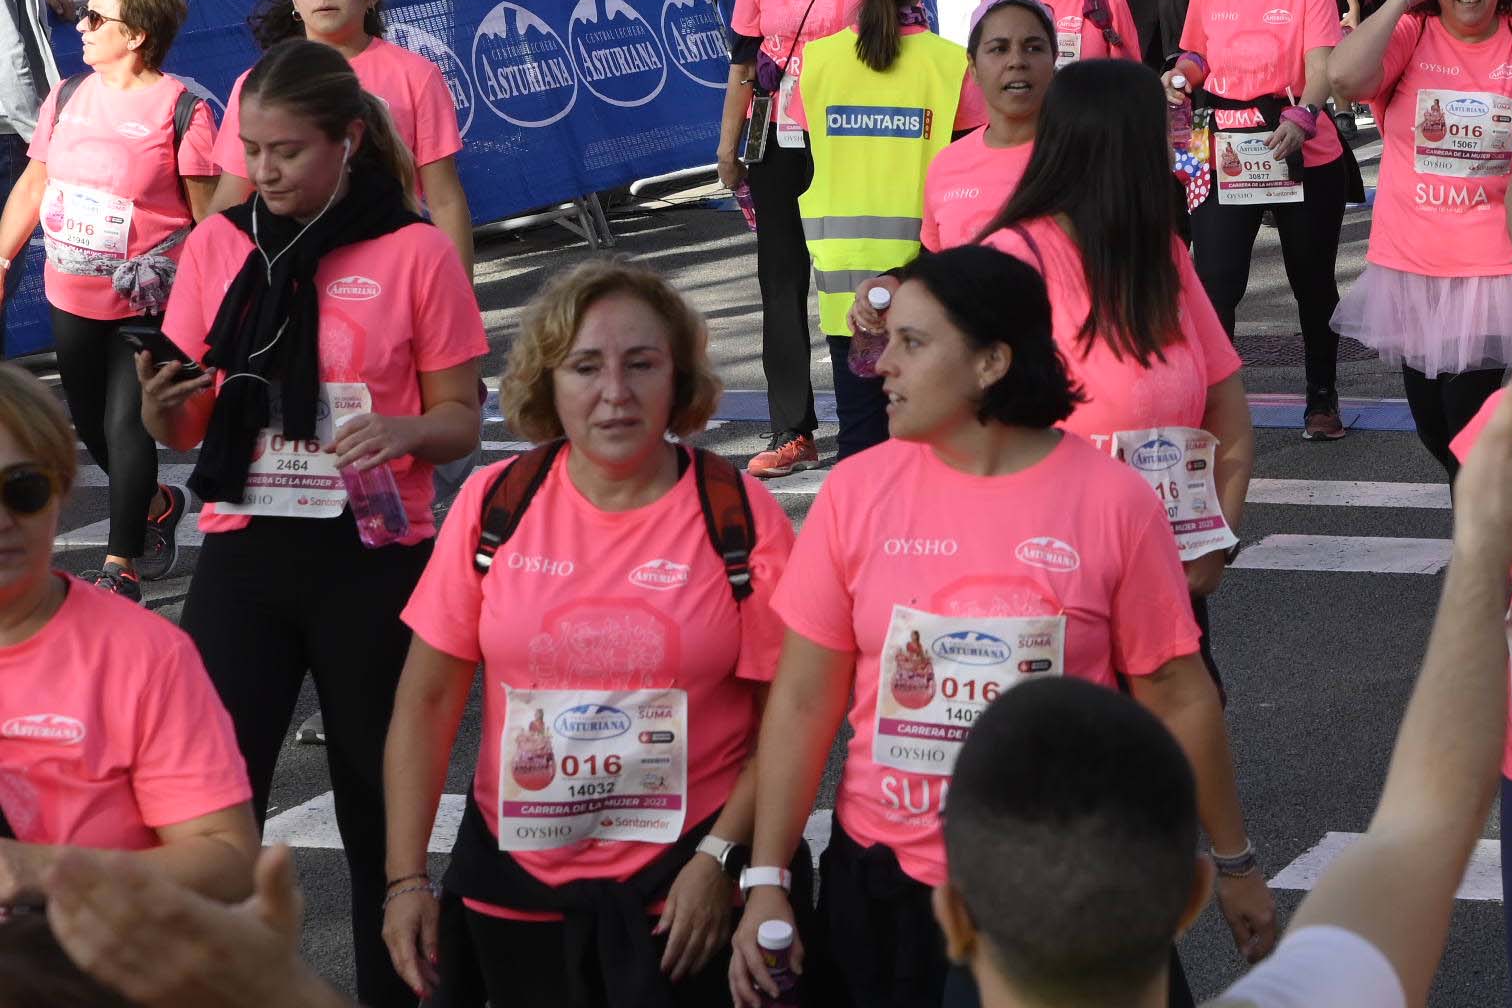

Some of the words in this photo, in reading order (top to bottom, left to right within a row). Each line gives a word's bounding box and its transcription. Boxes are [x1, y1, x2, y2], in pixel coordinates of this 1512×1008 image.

[585, 30, 614, 44] CENTRAL
[577, 38, 662, 83] ASTURIANA
[1419, 62, 1460, 76] OYSHO
[482, 54, 573, 101] ASTURIANA
[828, 113, 920, 131] OLUNTARIS
[1216, 108, 1266, 129] SUMA
[1450, 124, 1483, 137] 016
[1453, 140, 1478, 149] 15067
[1244, 160, 1272, 172] 016
[1423, 160, 1452, 169] OYSHO
[943, 187, 980, 200] OYSHO
[1415, 183, 1488, 205] SUMA
[66, 218, 95, 236] 016
[334, 400, 362, 409] SUMA
[277, 459, 309, 472] 2464
[275, 476, 287, 485] DE
[288, 477, 300, 486] LA
[302, 478, 332, 488] MUJER
[1155, 482, 1179, 500] 16
[884, 538, 958, 556] OYSHO
[1021, 545, 1075, 567] ASTURIANA
[507, 552, 574, 577] OYSHO
[937, 642, 1005, 661] ASTURIANA
[1017, 638, 1052, 649] SUMA
[941, 677, 1000, 705] 016
[638, 709, 673, 720] SUMA
[9, 721, 78, 739] ASTURIANA
[556, 717, 626, 733] ASTURIANA
[897, 723, 945, 738] CARRERA
[948, 727, 963, 738] DE
[890, 745, 945, 762] OYSHO
[561, 754, 622, 777] 016
[568, 782, 615, 798] 14032
[521, 804, 570, 816] CARRERA
[573, 803, 586, 814] DE
[589, 801, 603, 812] LA
[605, 798, 640, 809] MUJER
[614, 816, 670, 830] Santander
[516, 825, 572, 840] OYSHO
